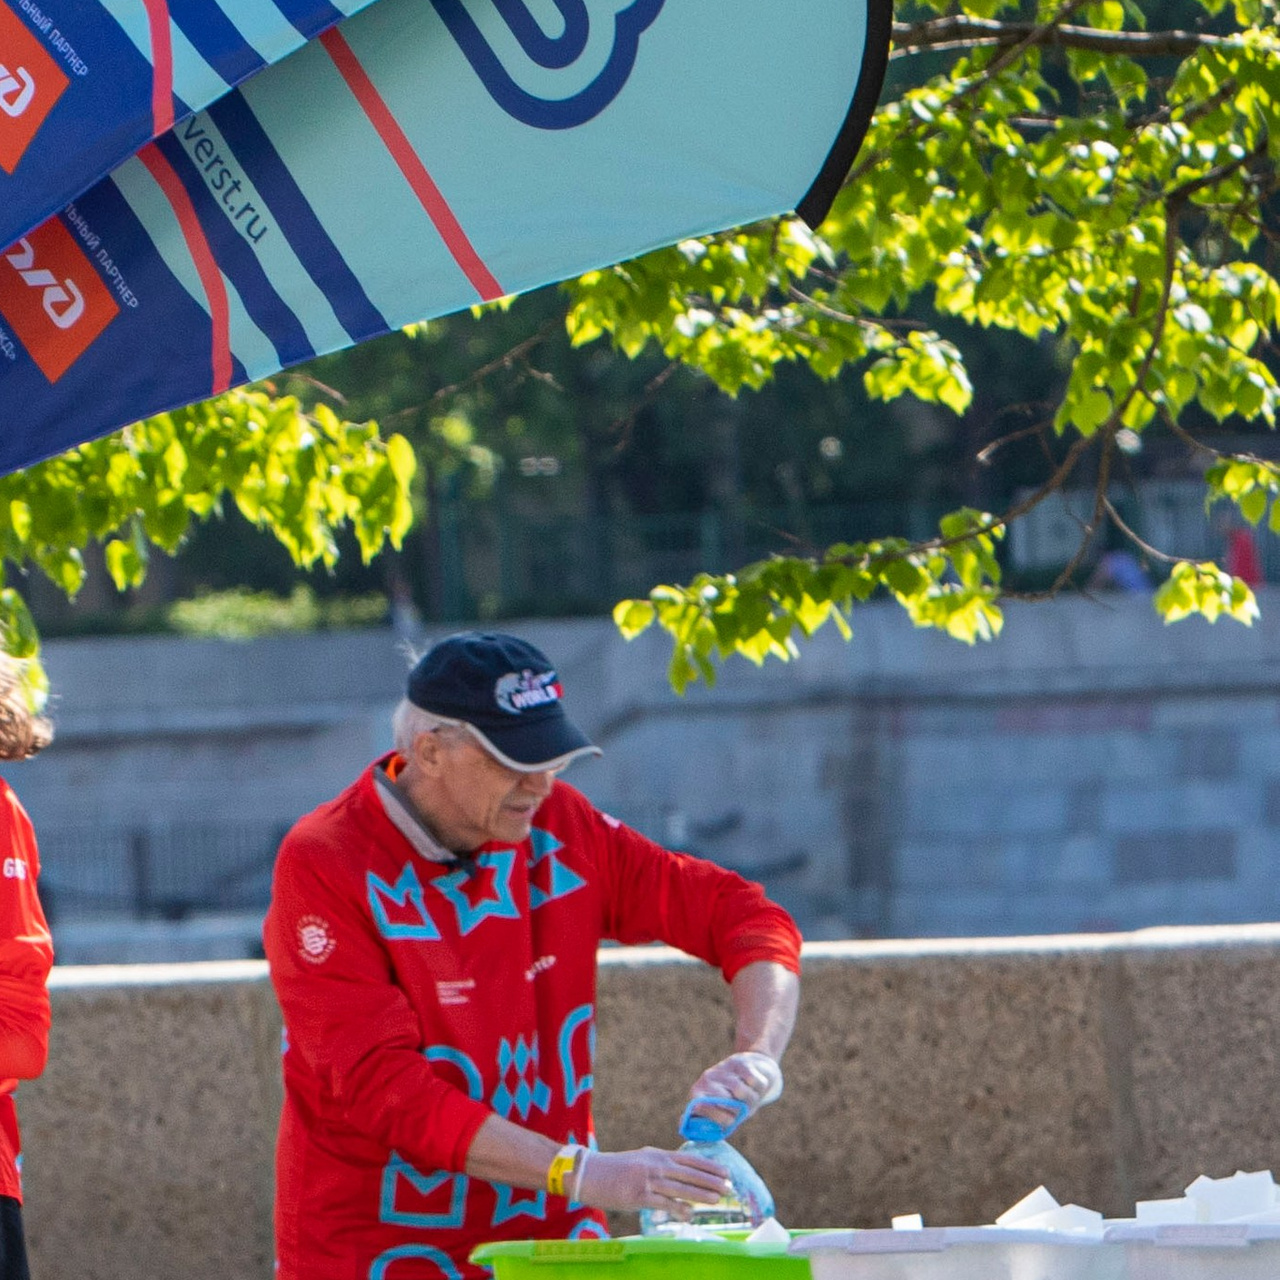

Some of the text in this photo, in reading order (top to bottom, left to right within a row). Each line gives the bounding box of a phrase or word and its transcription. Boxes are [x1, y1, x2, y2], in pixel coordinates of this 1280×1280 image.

[49, 28, 89, 77] ПАРТНЕР
[184, 115, 268, 244] verst.ru
[97, 248, 139, 309] ПАРТНЕР
